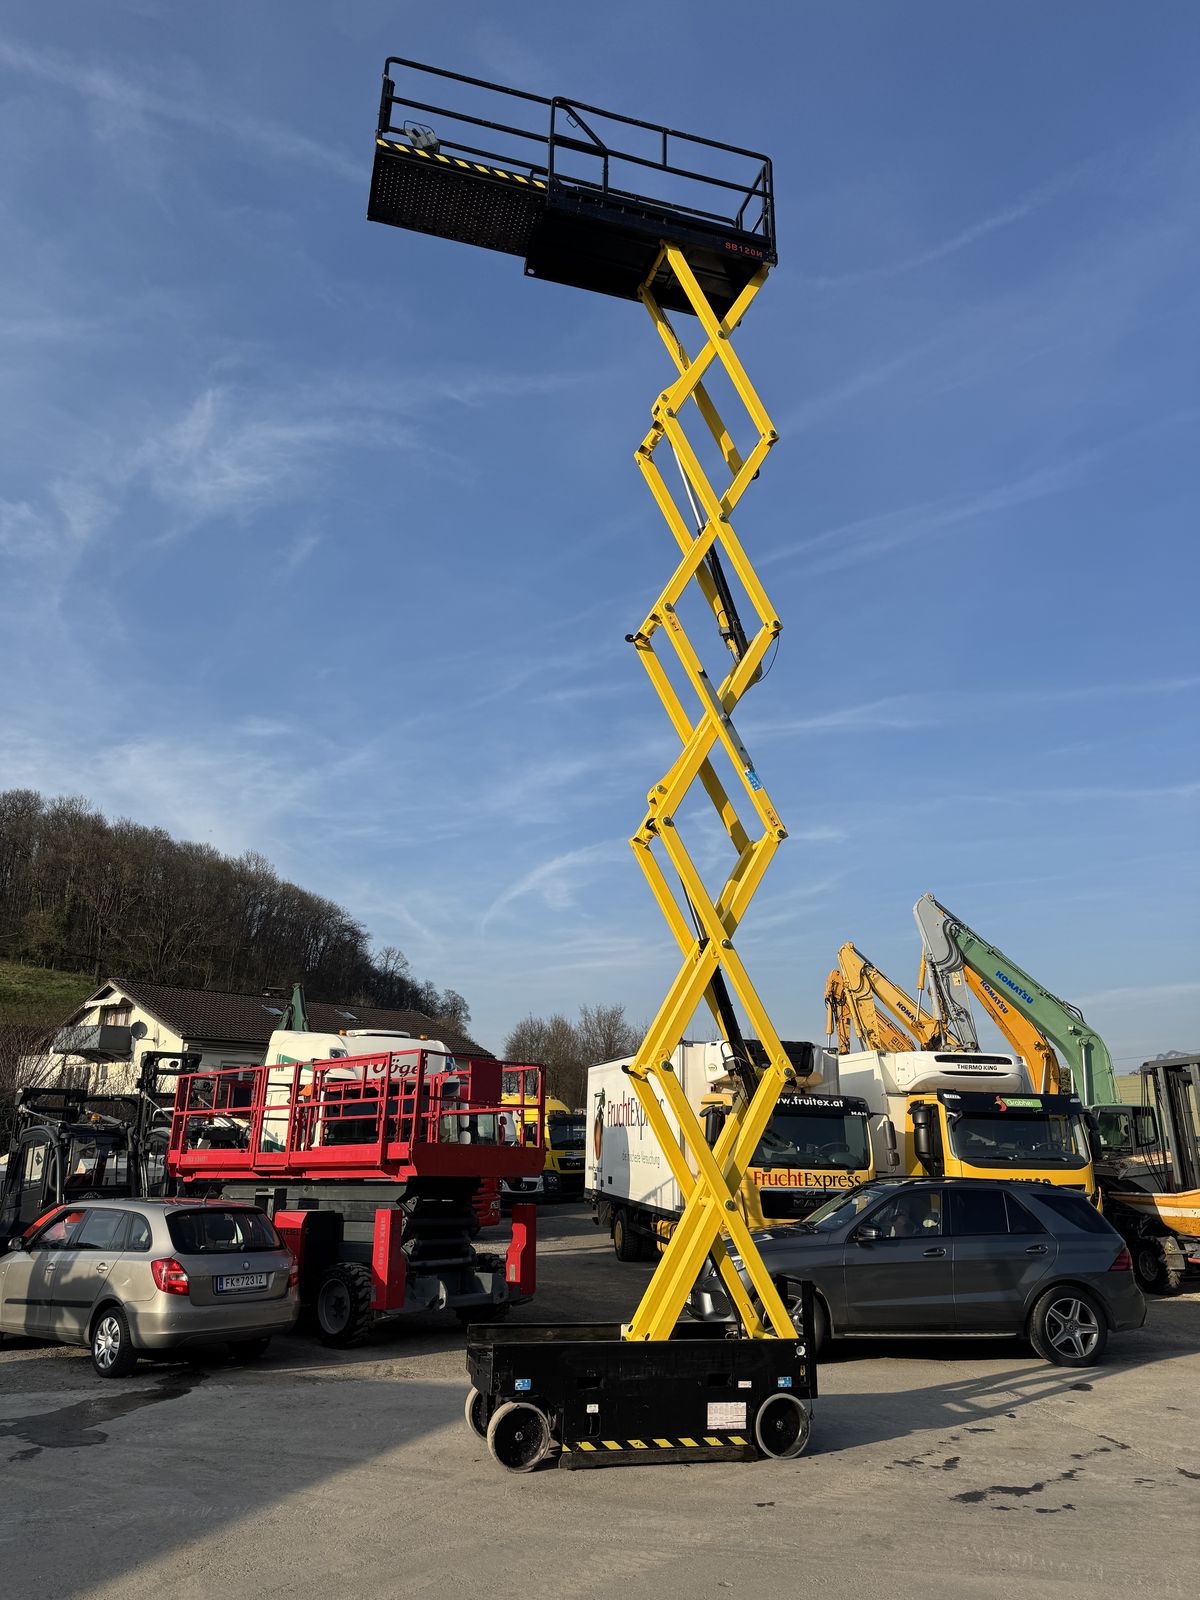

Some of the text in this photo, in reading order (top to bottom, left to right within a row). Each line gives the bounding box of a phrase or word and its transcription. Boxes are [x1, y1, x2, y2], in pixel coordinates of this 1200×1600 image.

[980, 980, 1009, 1015] KOMATSU
[995, 970, 1035, 1005] KOMATSU
[896, 1001, 917, 1023] KOMA
[753, 1168, 861, 1192] FruchtExpress
